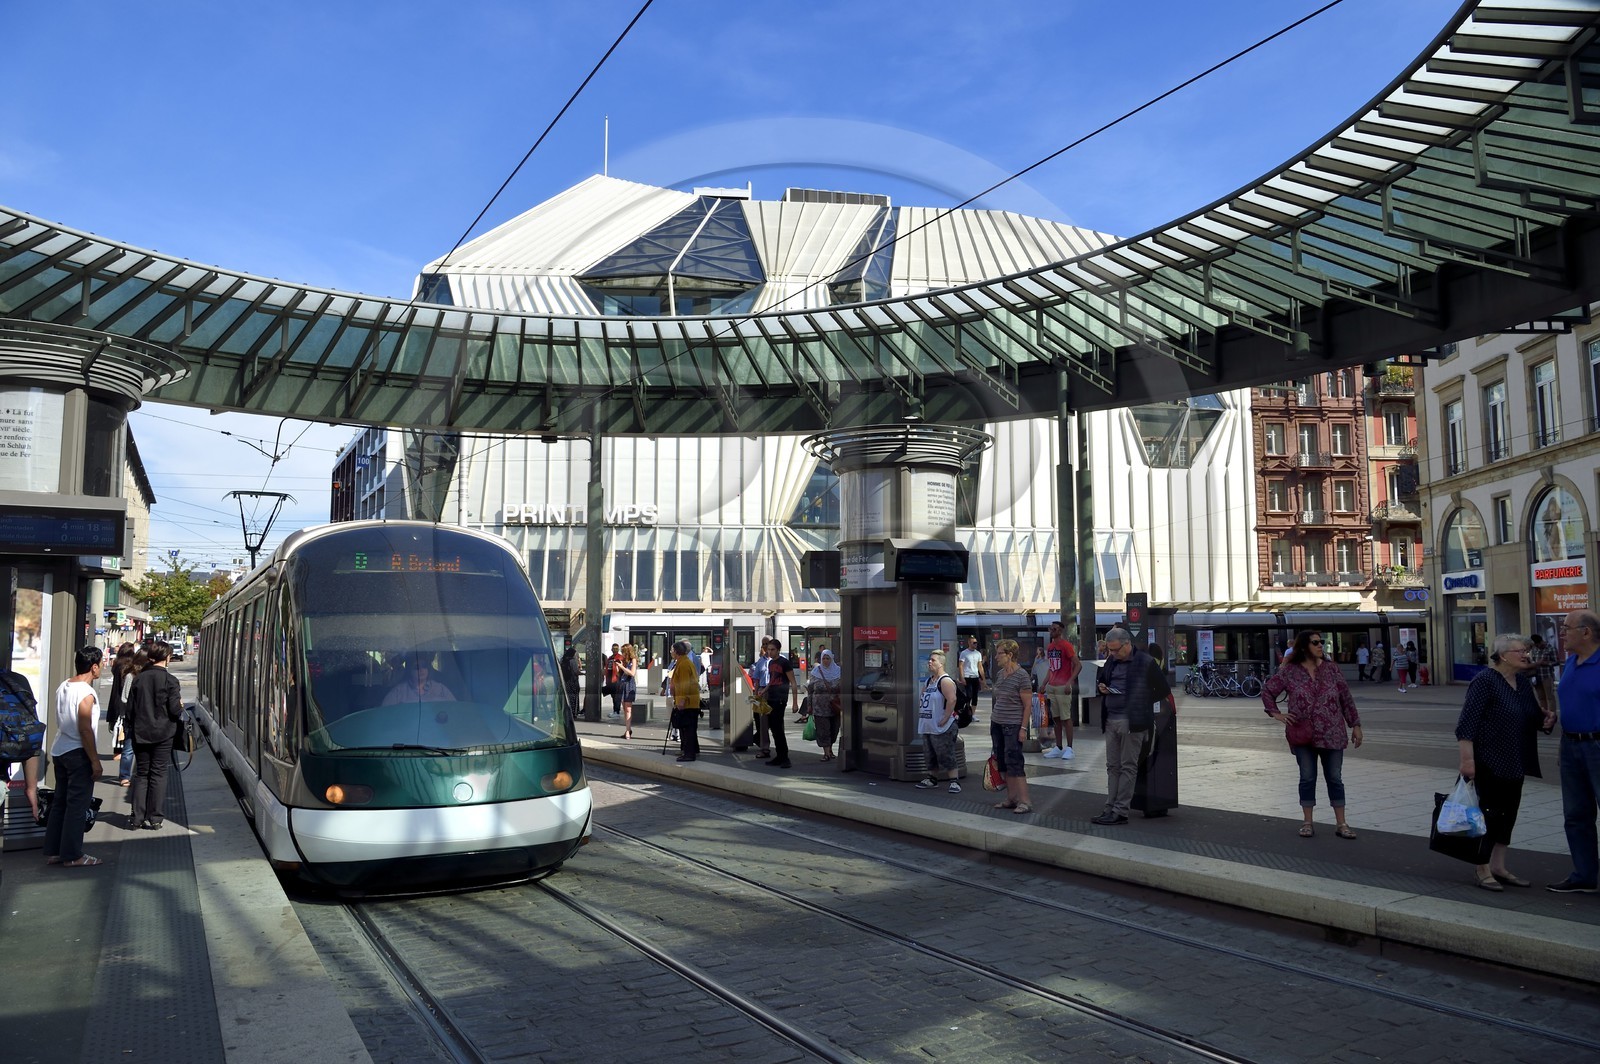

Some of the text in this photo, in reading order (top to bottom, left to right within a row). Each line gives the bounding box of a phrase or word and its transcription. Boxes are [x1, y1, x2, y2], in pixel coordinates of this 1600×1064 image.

[357, 457, 370, 465] 100
[502, 503, 659, 525] PRINTMPS
[60, 522, 69, 531] 4
[87, 523, 100, 532] 18
[92, 534, 99, 543] 9
[355, 552, 367, 569] D
[1534, 564, 1583, 580] PARFUMERIE
